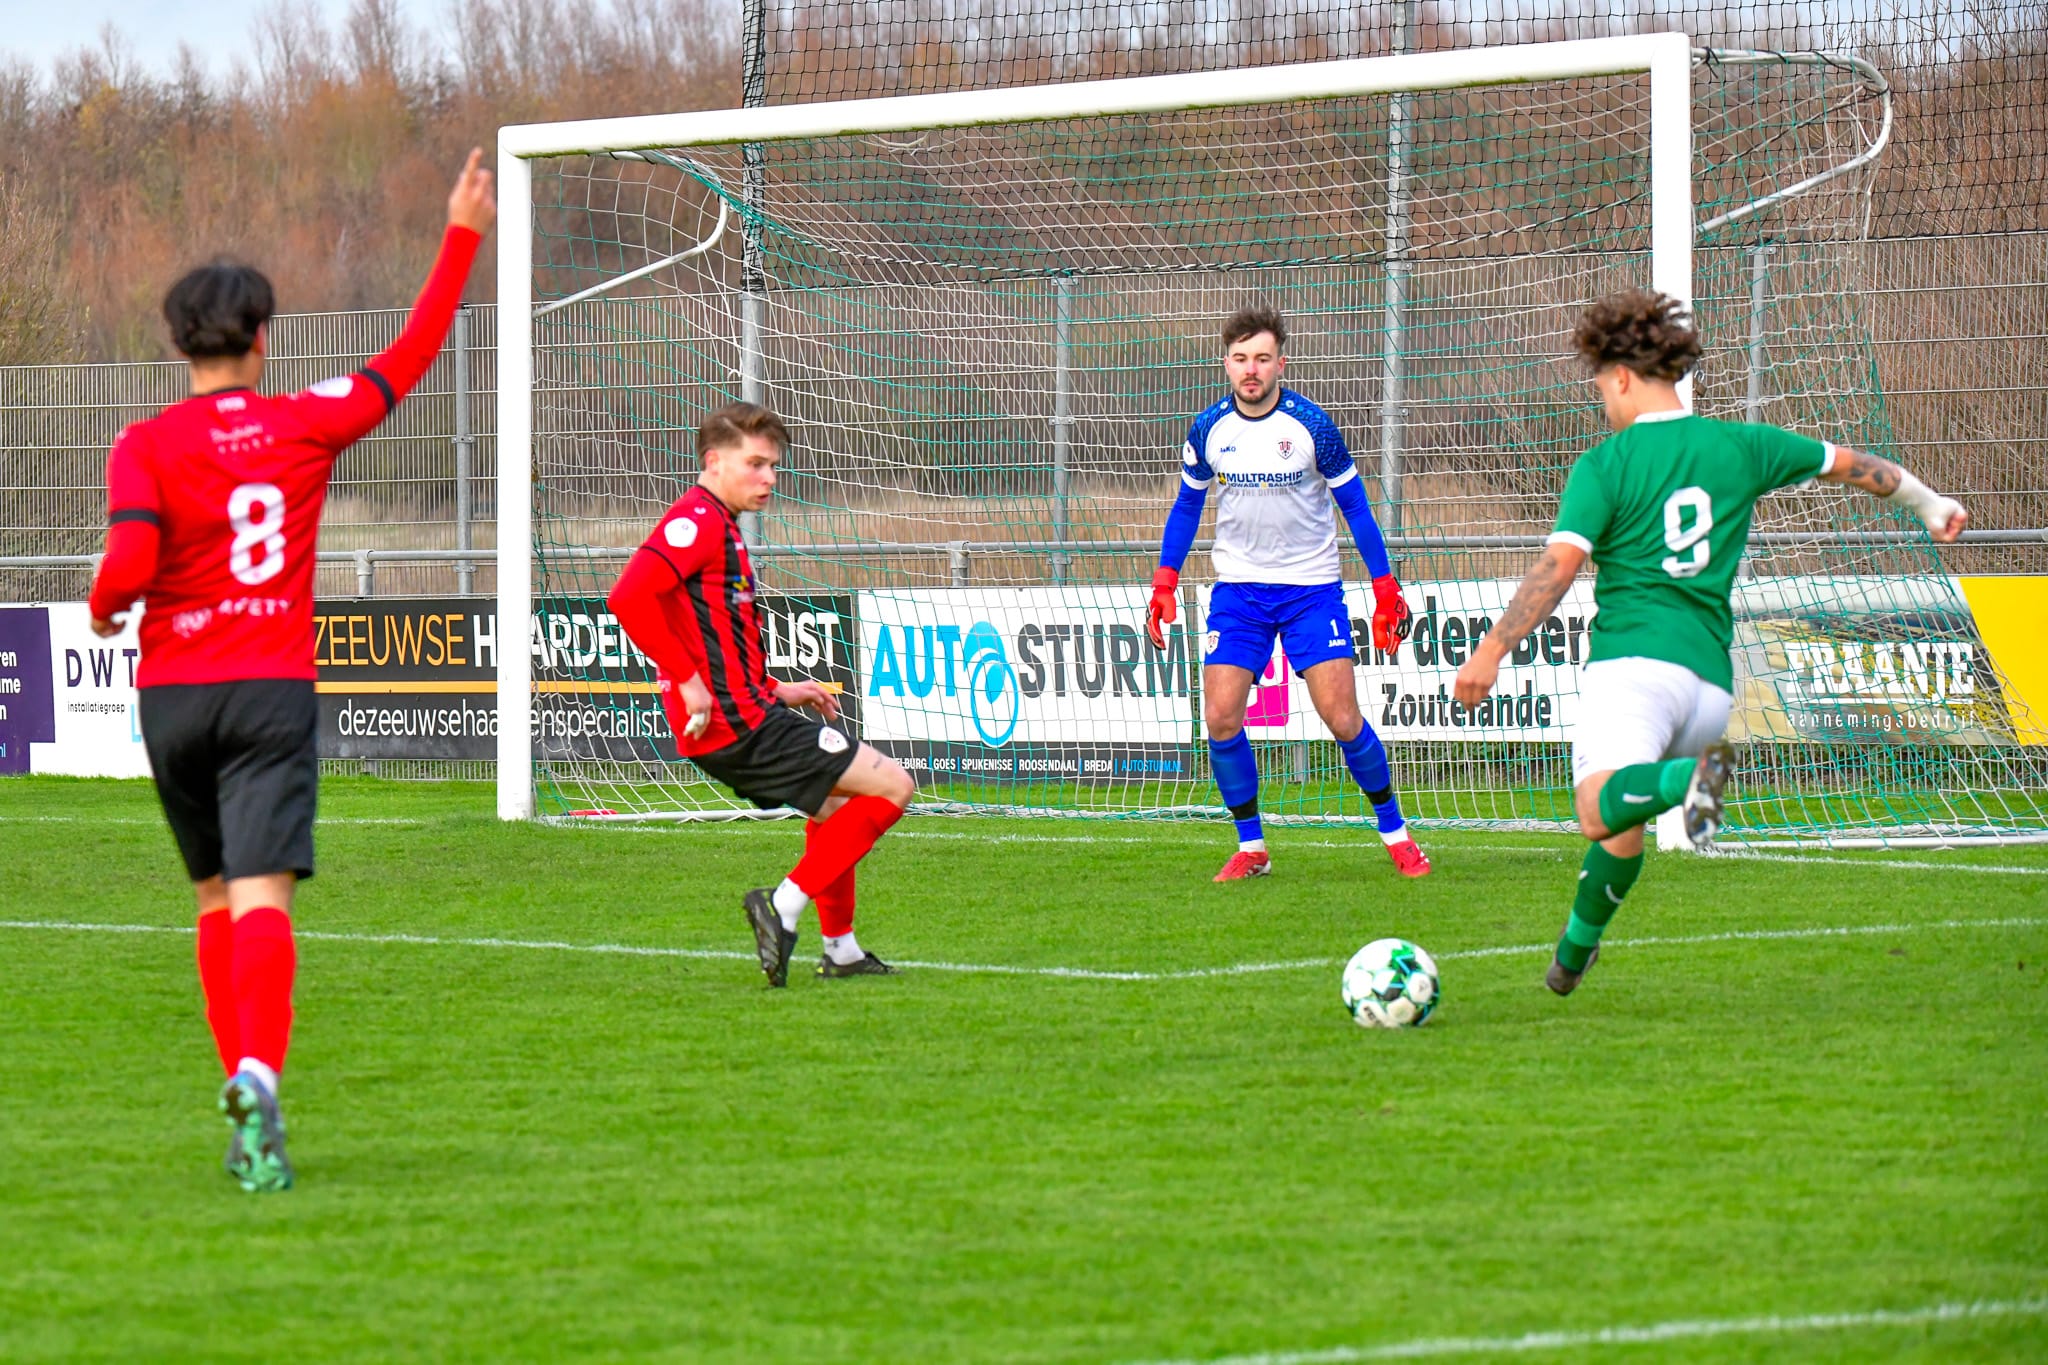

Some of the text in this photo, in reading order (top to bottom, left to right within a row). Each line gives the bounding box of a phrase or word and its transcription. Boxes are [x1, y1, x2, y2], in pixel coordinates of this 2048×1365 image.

[1226, 471, 1303, 483] MULTRASHIP
[227, 483, 287, 585] 8
[1661, 486, 1713, 579] 9
[311, 614, 466, 666] ZEEUWSE
[1329, 619, 1339, 637] 1
[1413, 595, 1494, 667] den
[1017, 623, 1187, 699] STURM
[1783, 641, 1975, 705] FRAANJE
[0, 678, 21, 694] me
[67, 701, 126, 715] installatiegroep
[1787, 710, 1975, 732] aannemingsbedrijf
[933, 758, 956, 770] GOES
[961, 759, 1013, 771] SPIJKENISSE
[1018, 759, 1078, 772] ROOSENDAAL
[1084, 760, 1113, 772] BREDA
